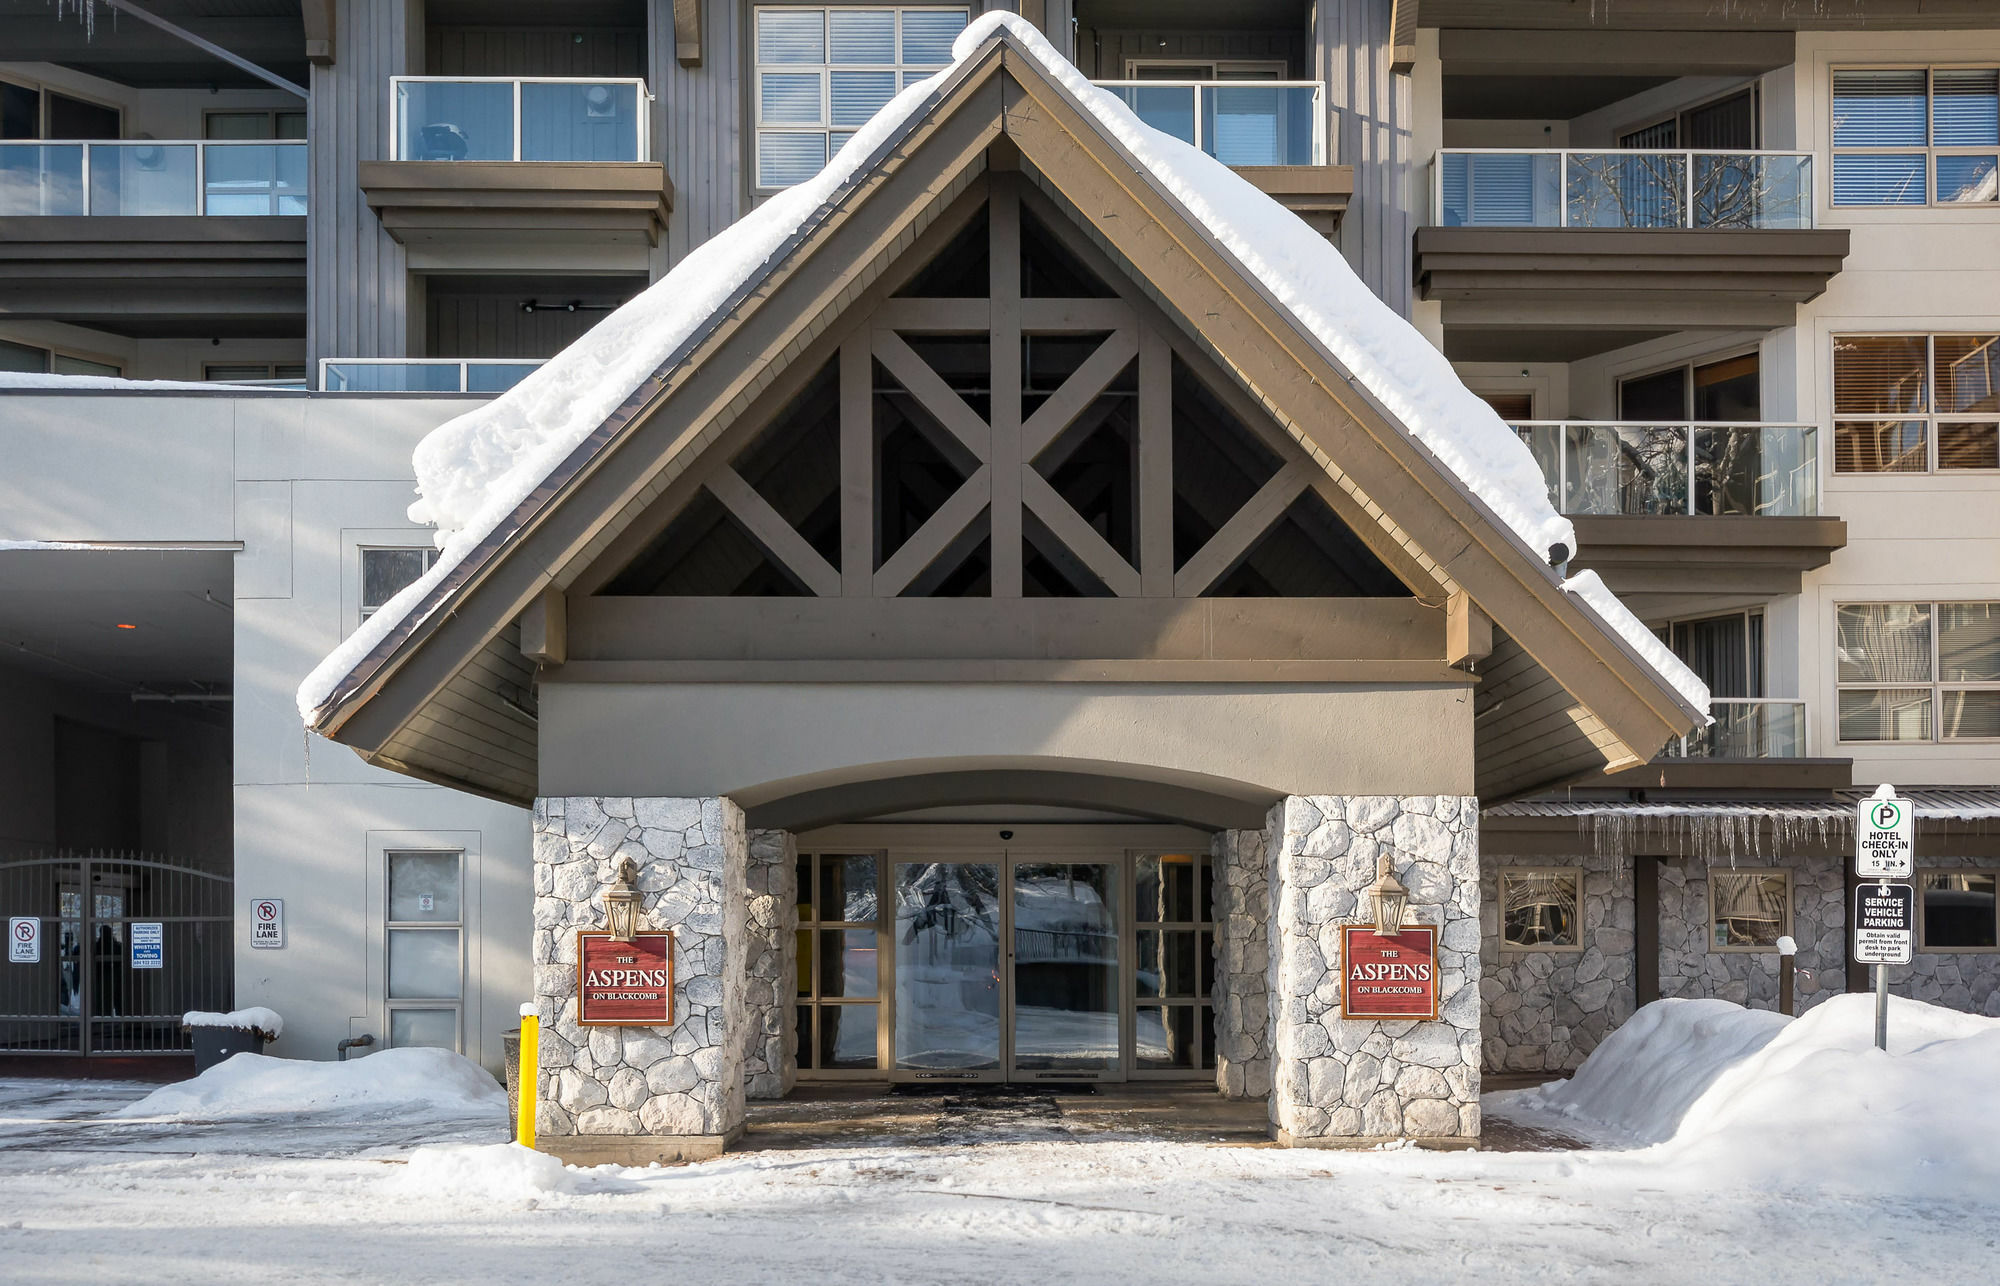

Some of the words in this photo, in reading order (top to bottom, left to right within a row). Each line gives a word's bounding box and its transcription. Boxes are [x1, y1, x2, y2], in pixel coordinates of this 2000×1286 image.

[1880, 808, 1894, 824] P
[1870, 832, 1901, 840] HOTEL
[1862, 841, 1908, 849] CHECK-IN
[1872, 850, 1898, 858] ONLY
[1878, 888, 1892, 896] NO
[1865, 898, 1904, 906] SERVICE
[1864, 908, 1904, 917] VEHICLE
[1864, 918, 1904, 927] PARKING
[1351, 964, 1430, 980] ASPENS
[586, 970, 666, 987] ASPENS
